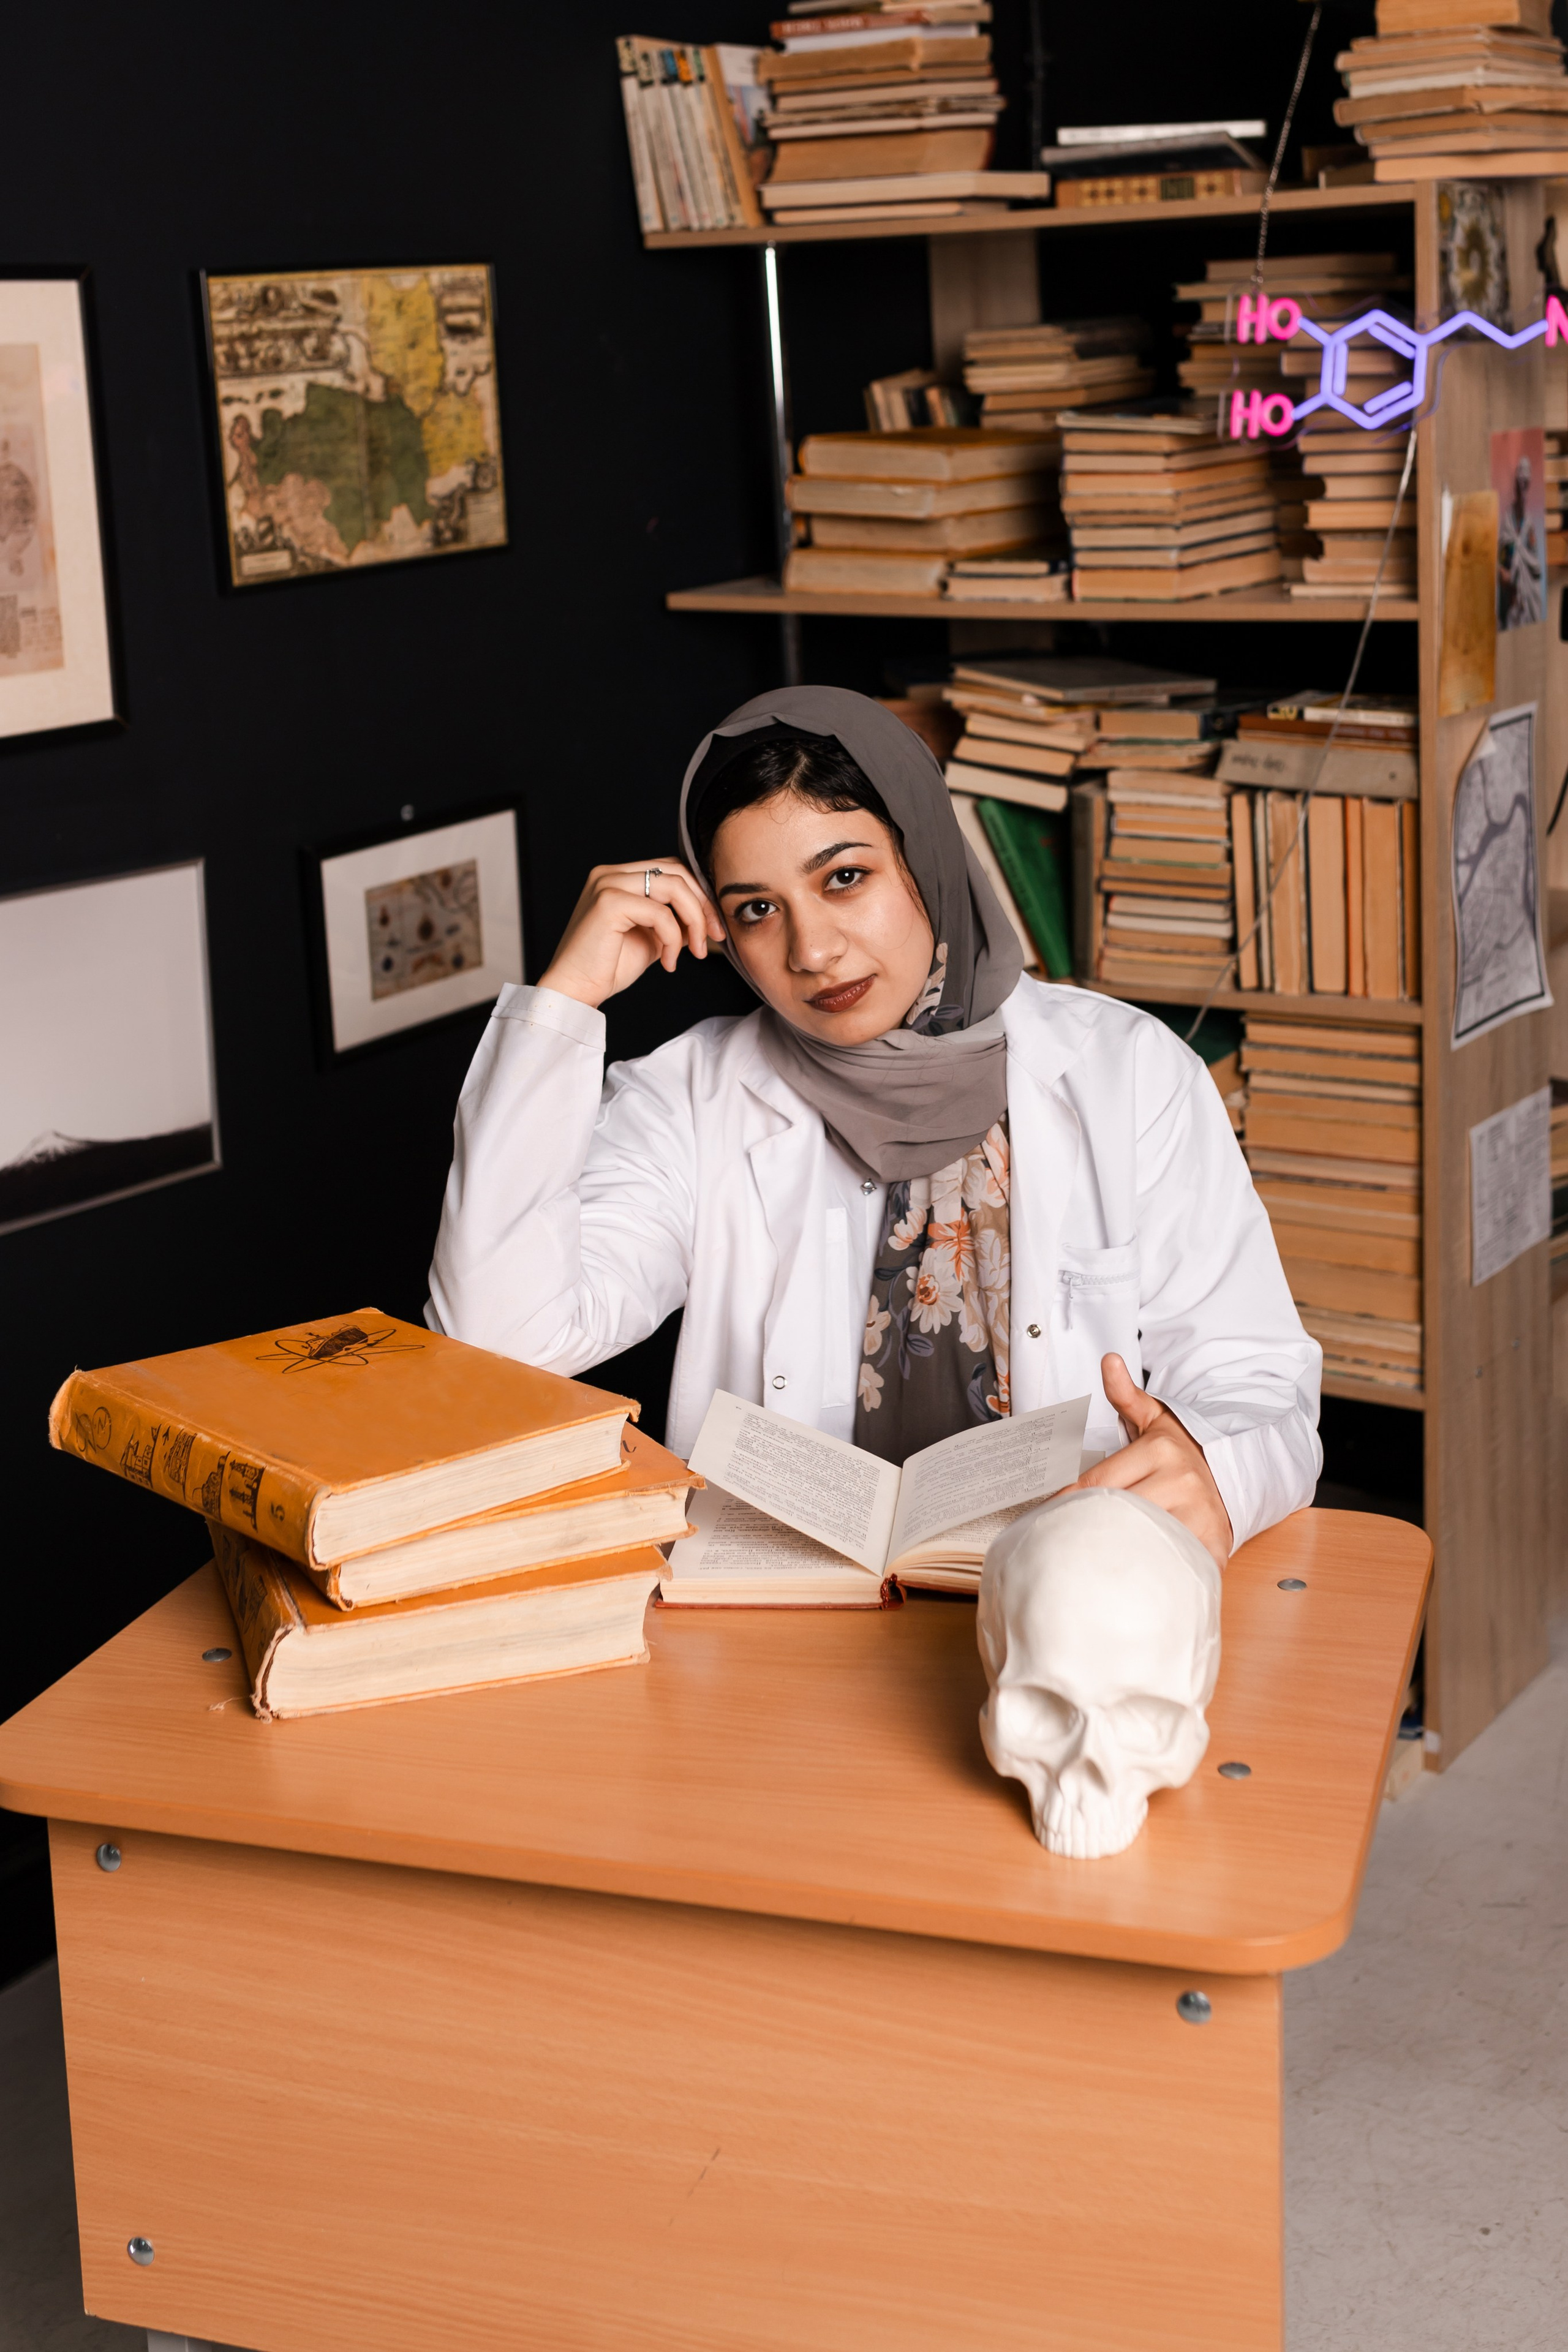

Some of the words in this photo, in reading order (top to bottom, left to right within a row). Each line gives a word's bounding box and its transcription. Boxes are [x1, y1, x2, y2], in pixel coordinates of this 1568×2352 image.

[1237, 293, 1302, 344] HO
[1230, 389, 1294, 439] HO
[270, 1501, 286, 1523] 5
